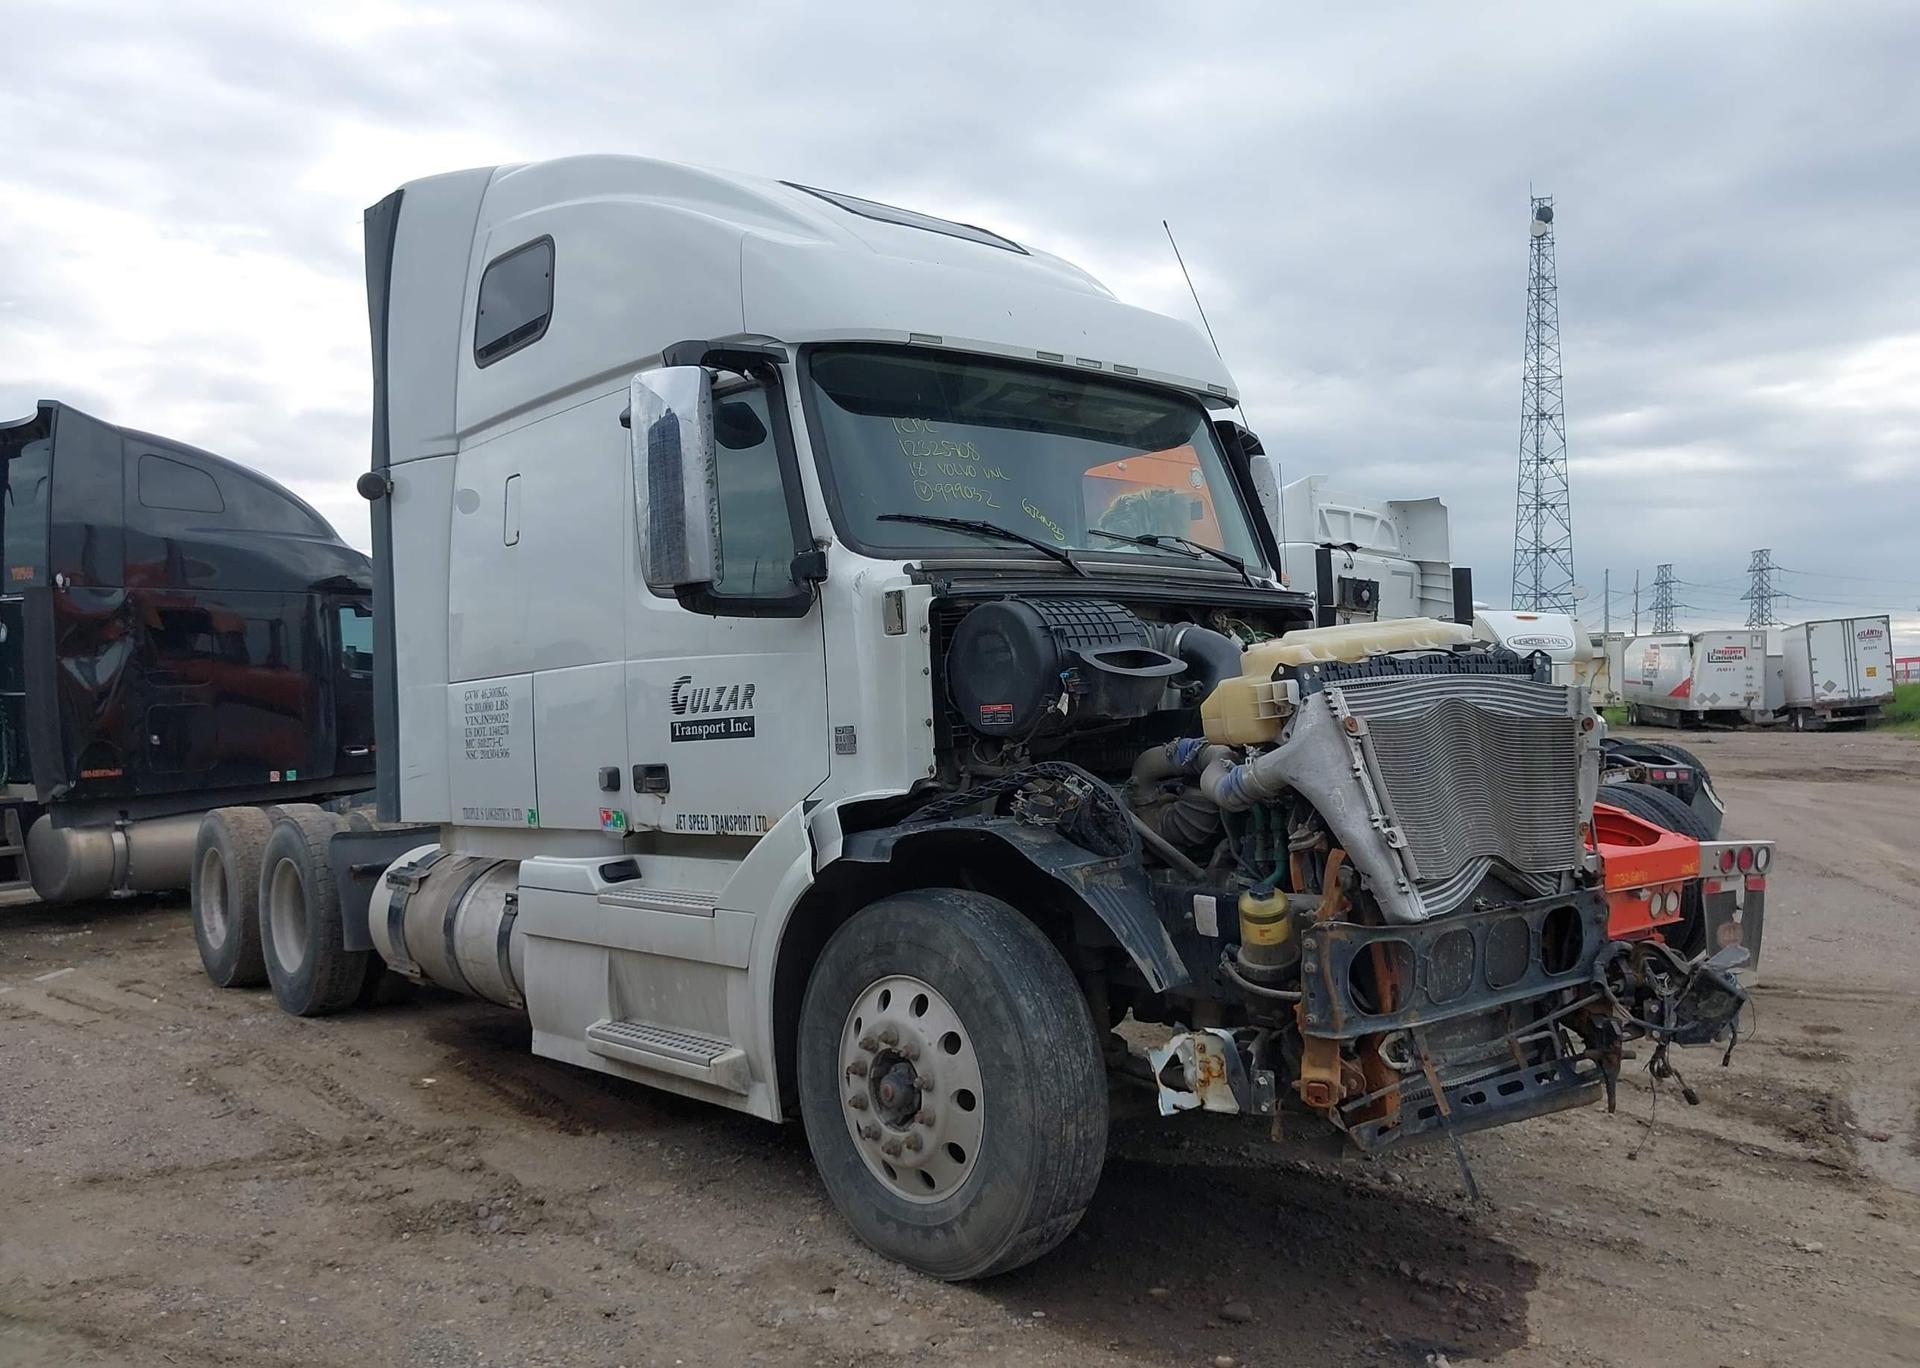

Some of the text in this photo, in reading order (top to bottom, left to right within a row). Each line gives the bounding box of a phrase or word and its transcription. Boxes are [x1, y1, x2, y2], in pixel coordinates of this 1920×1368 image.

[937, 462, 977, 479] VOLVO
[670, 675, 756, 715] GULZAR
[495, 699, 509, 711] LBS
[673, 718, 752, 740] Transport Inc.
[676, 814, 687, 831] JET
[688, 814, 709, 832] SPEED
[711, 814, 752, 833] TRANSPORT
